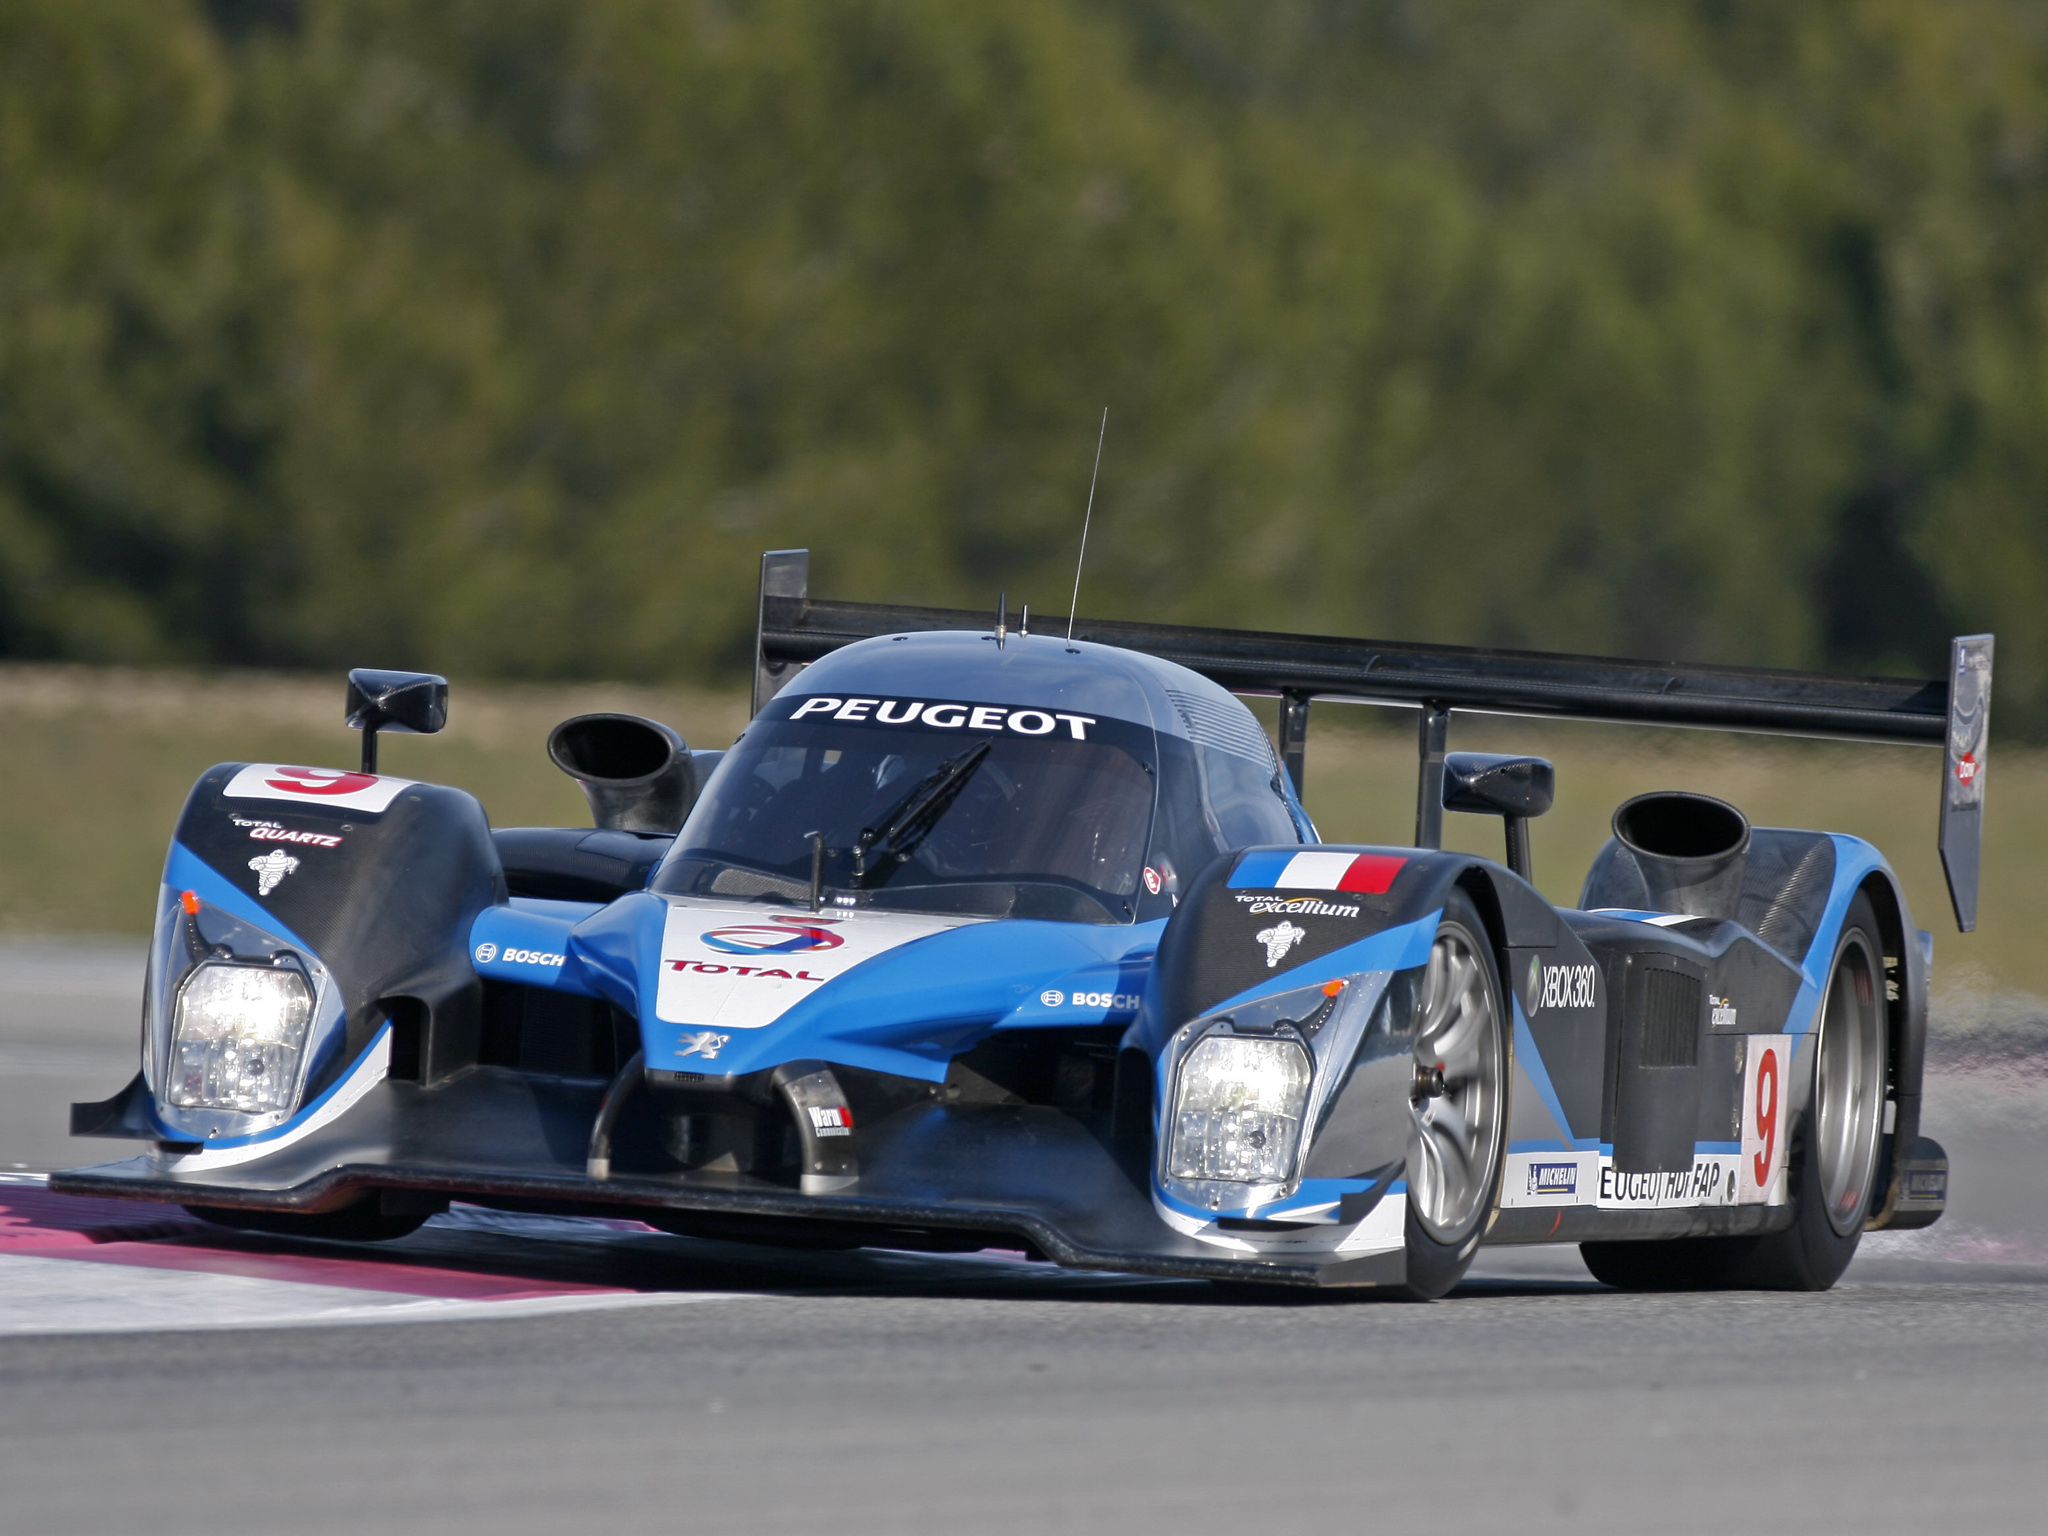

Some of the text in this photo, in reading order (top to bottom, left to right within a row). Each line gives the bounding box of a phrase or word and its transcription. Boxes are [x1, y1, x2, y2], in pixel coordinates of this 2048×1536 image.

[788, 698, 1096, 741] PEUGEOT
[264, 766, 379, 795] 9
[232, 819, 283, 829] TOTAL
[249, 827, 343, 847] QUARTZ
[1235, 895, 1284, 903] TOTAL
[1249, 900, 1360, 918] excellium
[502, 948, 567, 967] BOSCH
[664, 959, 825, 982] TOTAL
[1072, 992, 1140, 1010] BOSCH
[808, 1106, 842, 1128] Warm
[1754, 1048, 1778, 1187] 9
[1538, 1167, 1577, 1186] MICHELIN
[1598, 1166, 1662, 1201] EUGEOT
[1691, 1162, 1720, 1198] FAP
